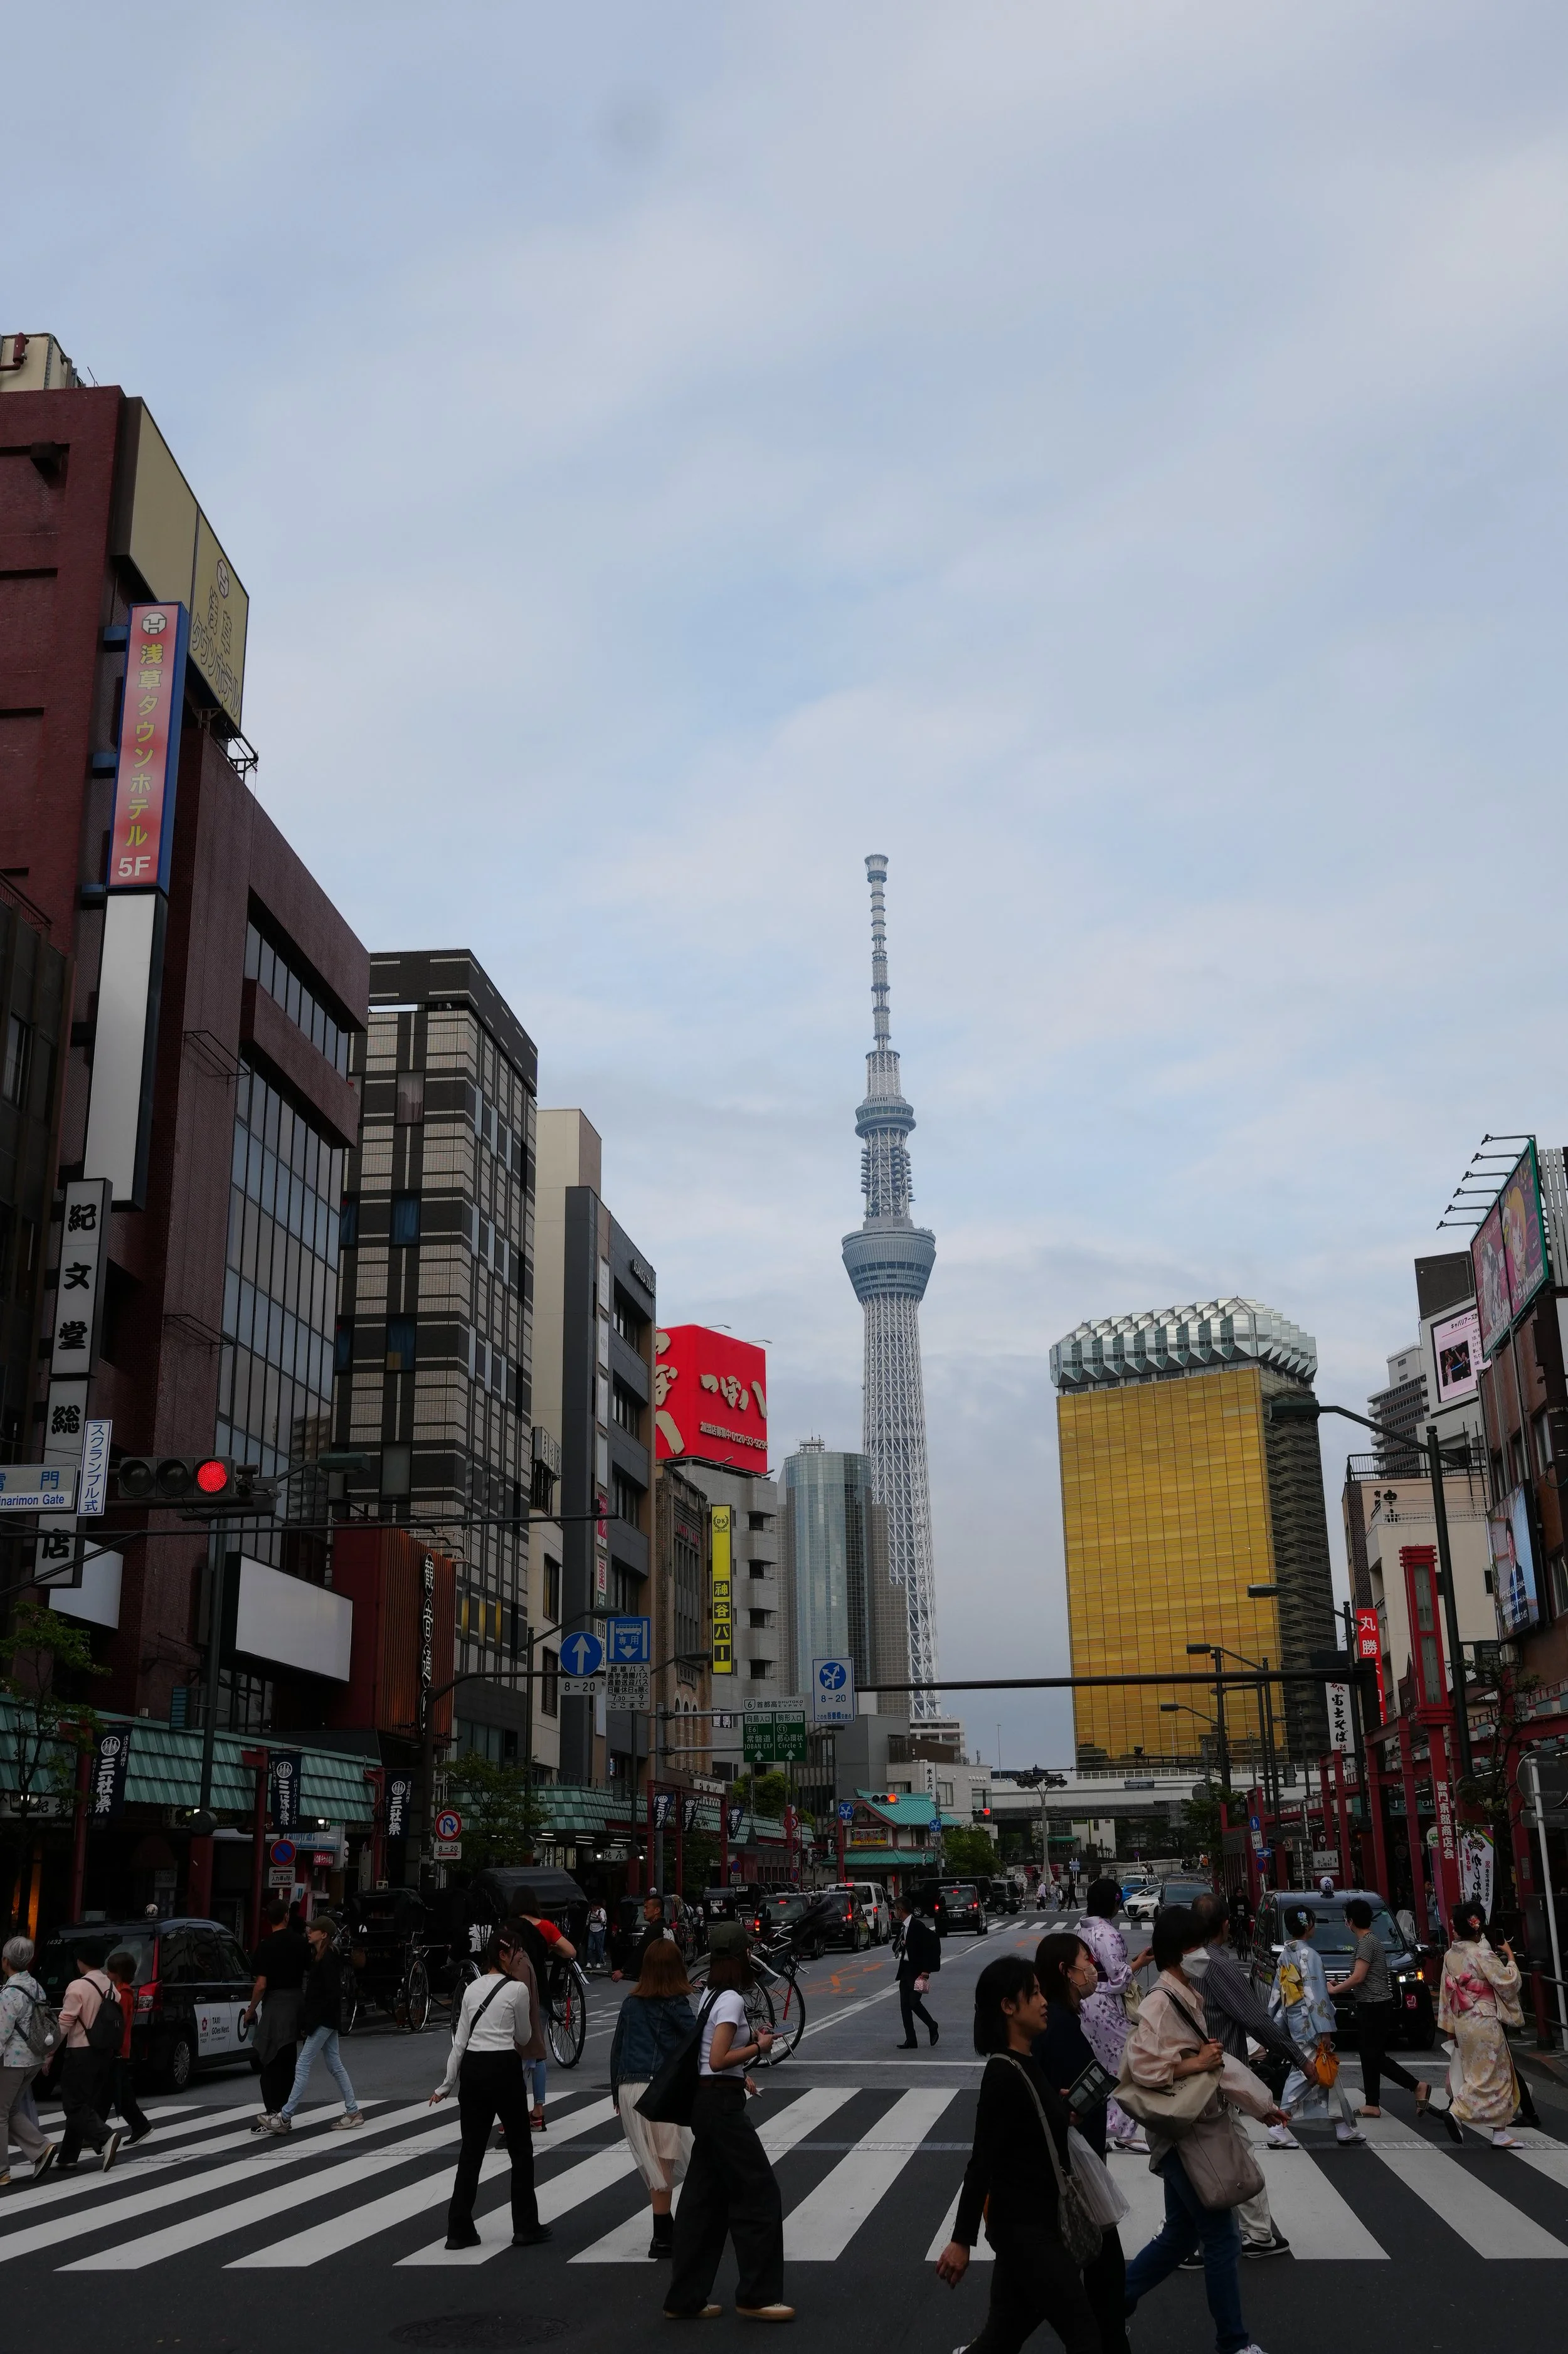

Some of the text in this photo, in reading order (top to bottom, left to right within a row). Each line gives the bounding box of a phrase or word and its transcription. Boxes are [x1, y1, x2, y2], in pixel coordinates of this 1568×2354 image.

[208, 586, 232, 655] 浅草
[192, 612, 240, 717] タウンホテル
[125, 644, 164, 847] 浅草タウンホテル
[117, 856, 151, 877] 5F
[41, 1204, 96, 1559] 紀文堂総店
[699, 1374, 768, 1419] つぼ八
[700, 1421, 732, 1441] 加盟店募集中
[84, 1424, 104, 1512] スクランブル式
[43, 1494, 65, 1505] Gate
[618, 1635, 639, 1645] 専用
[714, 1581, 730, 1661] 神谷バー
[746, 1715, 770, 1723] 向島入口
[777, 1734, 803, 1742] 都心環状
[778, 1714, 802, 1722] 駒形入口
[746, 1735, 771, 1743] 常磐道
[95, 1757, 115, 1813] 三社祭
[278, 1779, 290, 1826] 三社祭
[388, 1796, 403, 1836] 三社祭
[1436, 1781, 1454, 1859] 雷門東部商店会
[1324, 1879, 1332, 1890] 大和
[212, 2017, 221, 2025] TAXI
